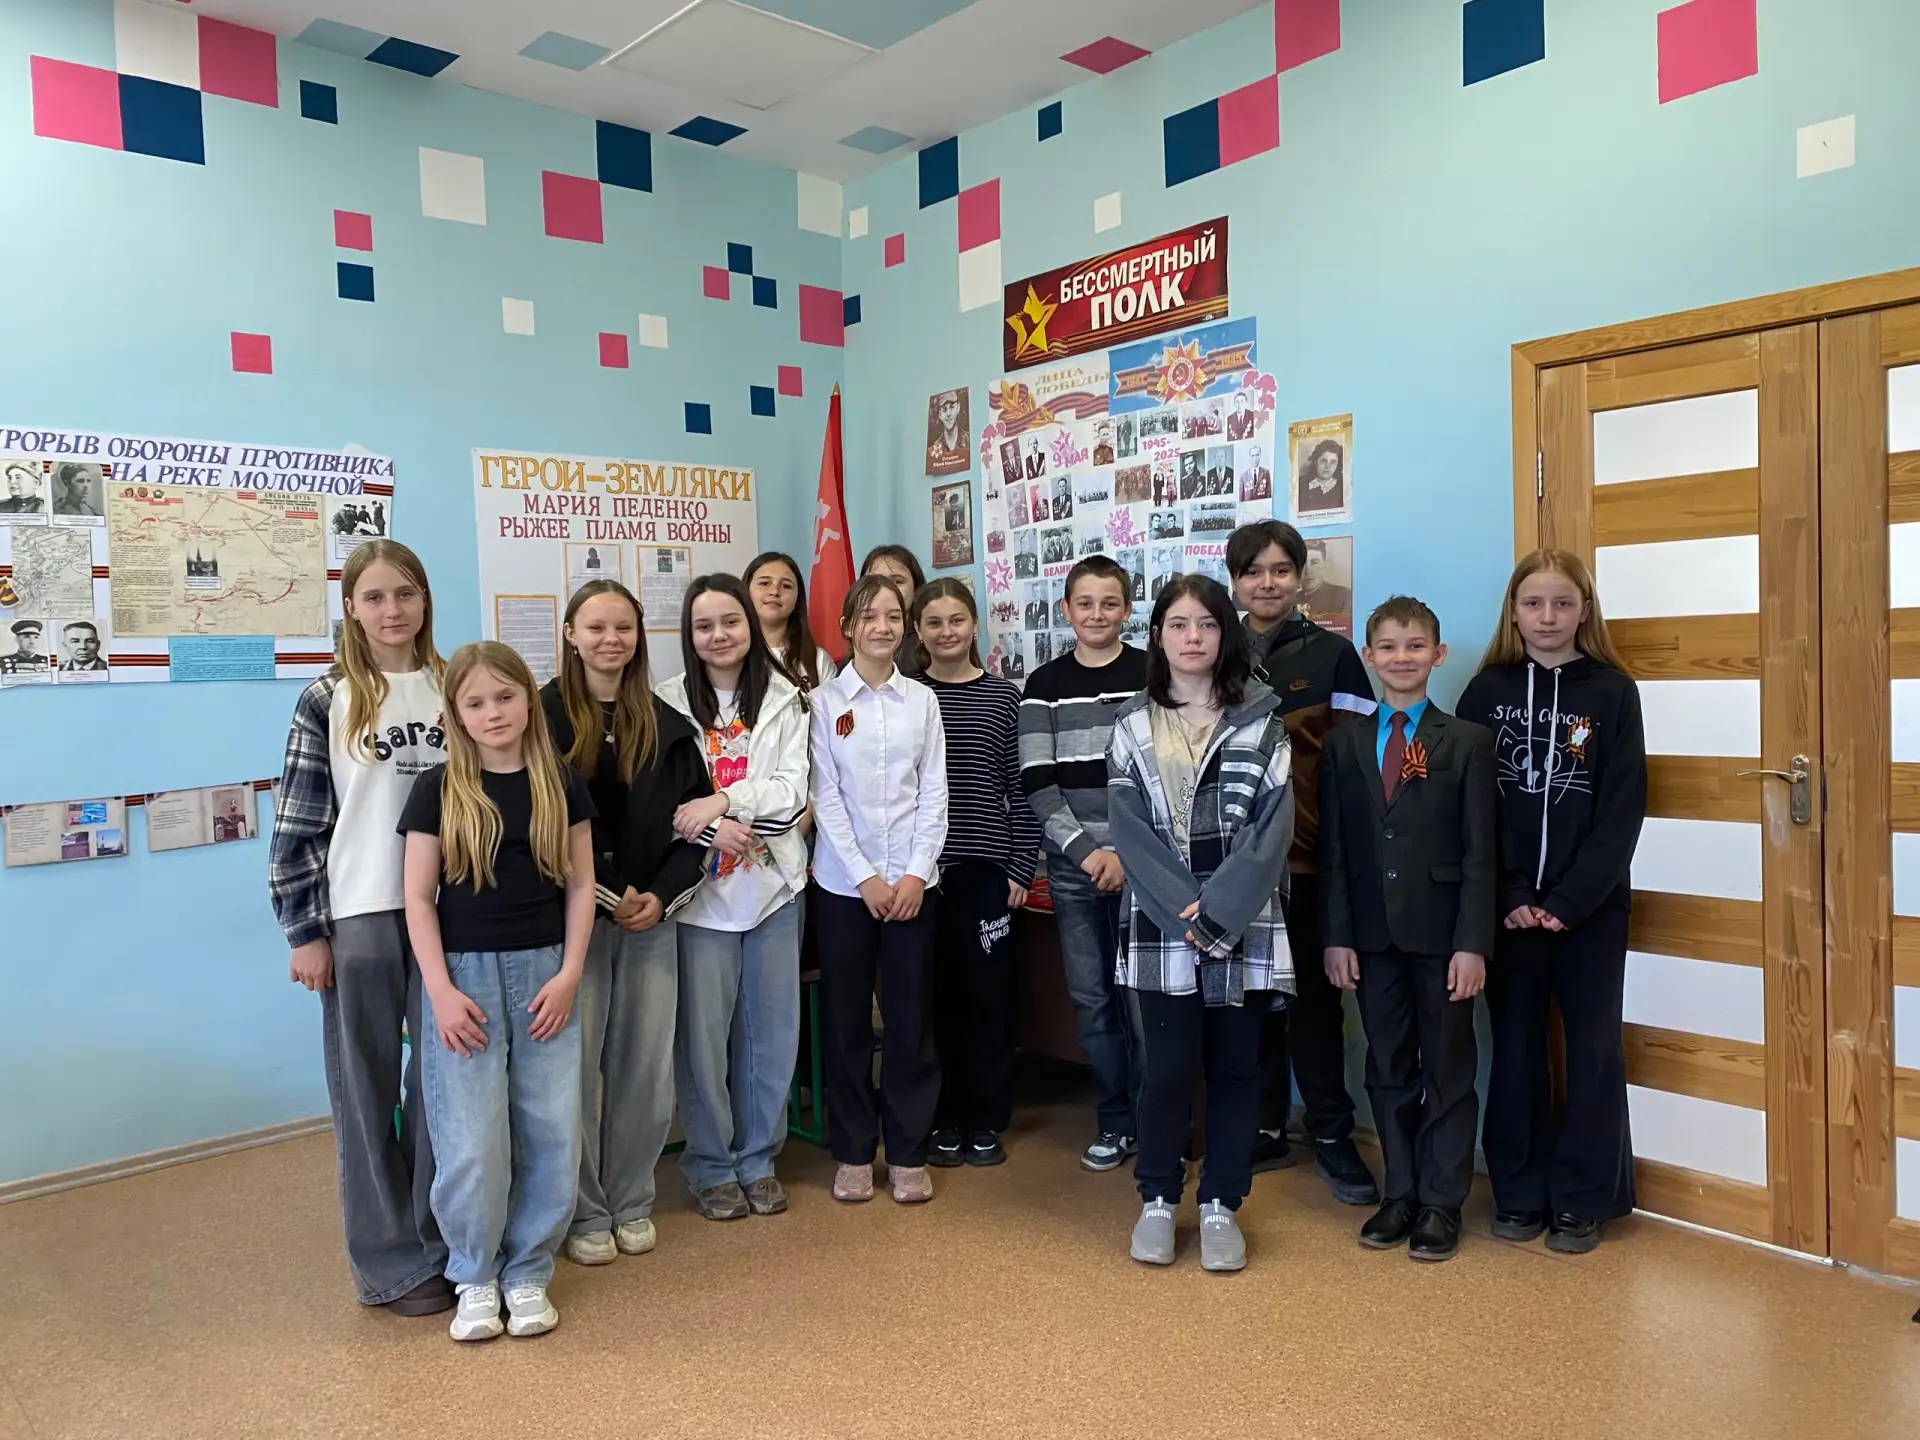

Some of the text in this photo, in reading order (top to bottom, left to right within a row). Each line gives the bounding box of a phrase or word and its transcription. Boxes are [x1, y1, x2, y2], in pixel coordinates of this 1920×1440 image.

[1060, 228, 1216, 304] БЕССМЕРТНЫЙ
[1090, 272, 1186, 331] ПОЛК
[0, 429, 394, 476] РОРЫВ ОБОРОНЫ ПРОТИВНИКА
[1154, 447, 1181, 461] 2025
[109, 462, 366, 496] НА РЕКЕ МОЛОЧНОЙ
[480, 455, 752, 501] ГЕРОИ-ЗЕМЛЯКИ
[523, 493, 708, 521] МАРИЯ ПЕДЕНКО
[499, 516, 731, 544] РЫЖЕЕ ПЛАМЯ ВОЙНЫ
[1145, 1208, 1172, 1220] PUMA
[1204, 1214, 1231, 1226] PUMA
